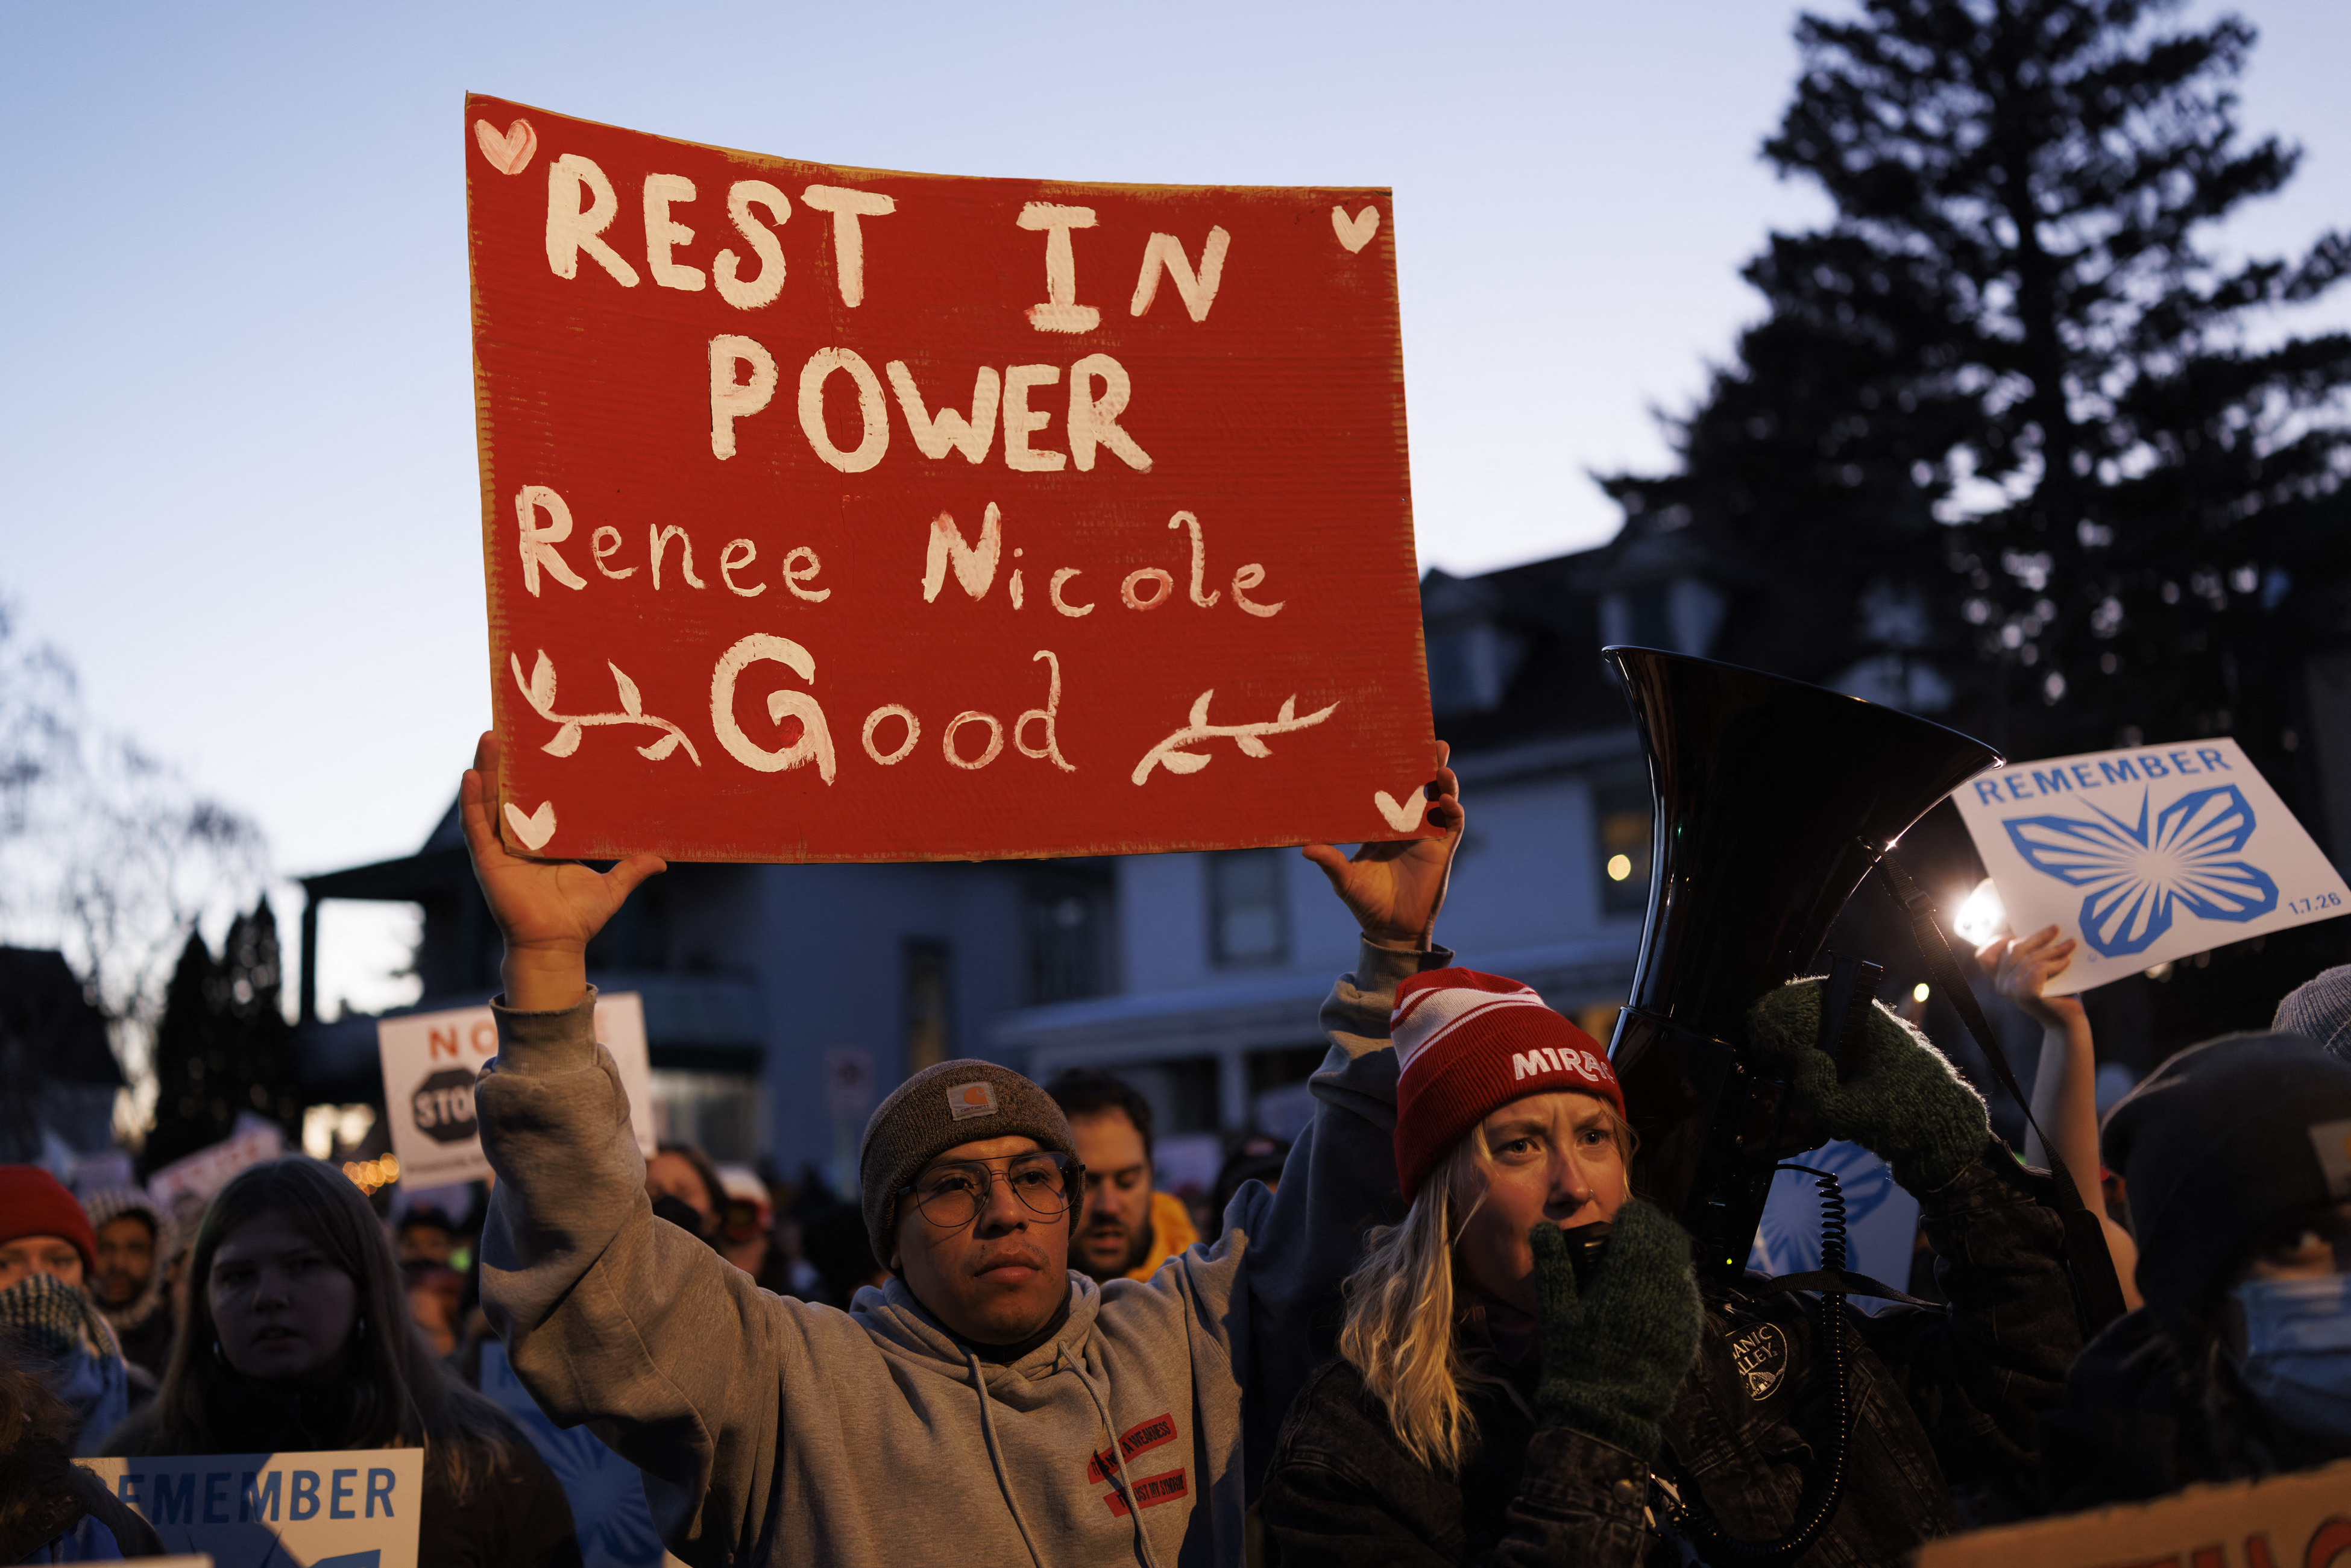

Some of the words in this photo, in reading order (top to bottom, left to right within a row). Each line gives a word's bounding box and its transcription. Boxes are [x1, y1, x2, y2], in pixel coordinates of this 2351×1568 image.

[546, 153, 898, 310] REST
[1016, 201, 1231, 334] IN
[708, 335, 1153, 473] POWER
[515, 485, 831, 602] Renee
[922, 502, 1286, 617] Nicole
[710, 632, 1077, 786] Good
[1973, 748, 2232, 806] REMEMBER
[2288, 892, 2341, 915] 1.7.26
[1733, 1326, 1772, 1359] ANIC
[1128, 1420, 1171, 1449] WEAKNESS
[116, 1467, 396, 1524] EMEMBER
